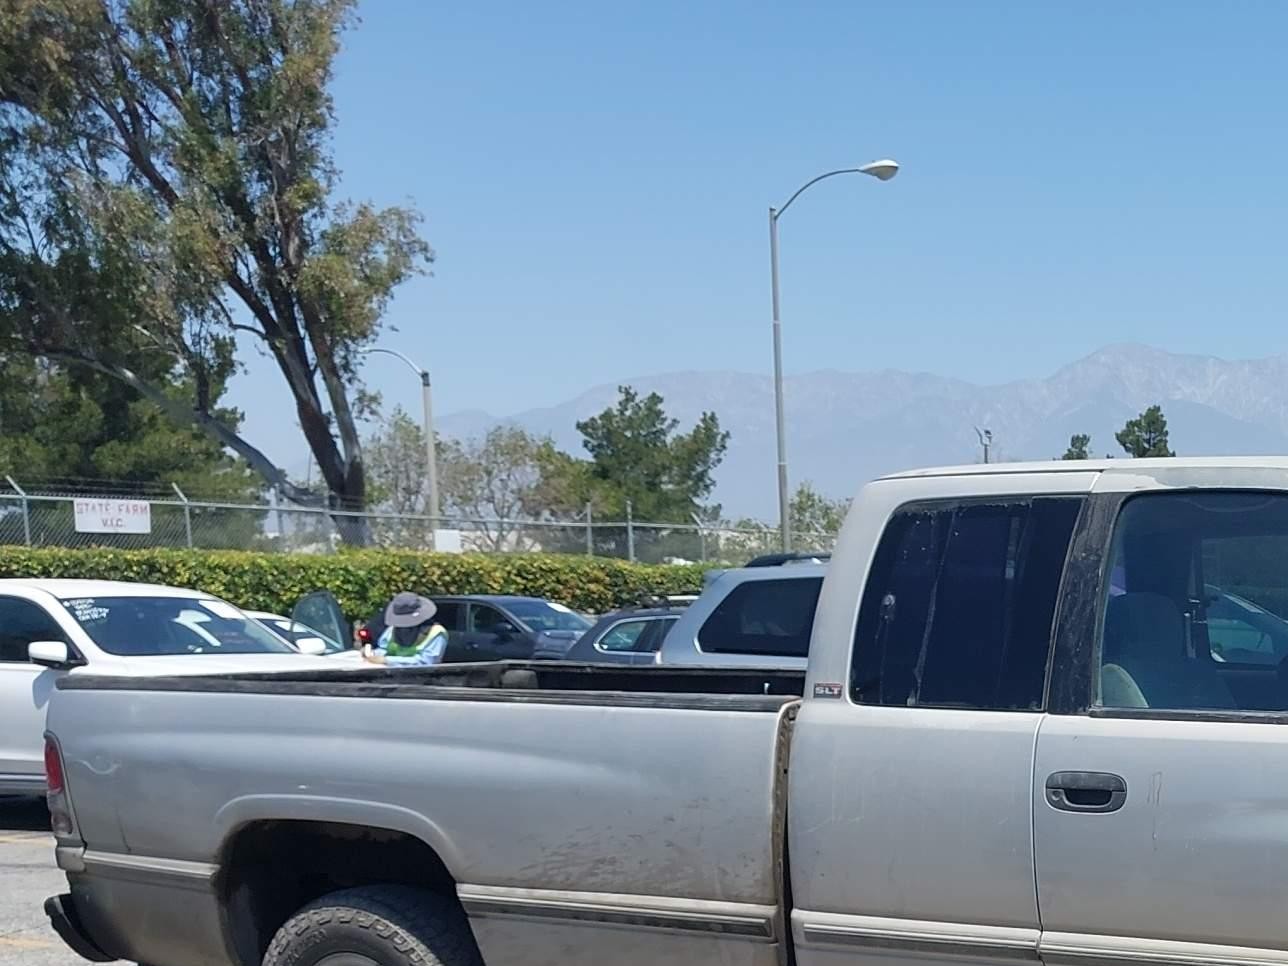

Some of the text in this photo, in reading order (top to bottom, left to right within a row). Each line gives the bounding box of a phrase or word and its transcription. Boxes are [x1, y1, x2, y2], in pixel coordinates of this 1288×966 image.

[76, 502, 148, 515] STATE FARM
[815, 685, 842, 695] SLT
